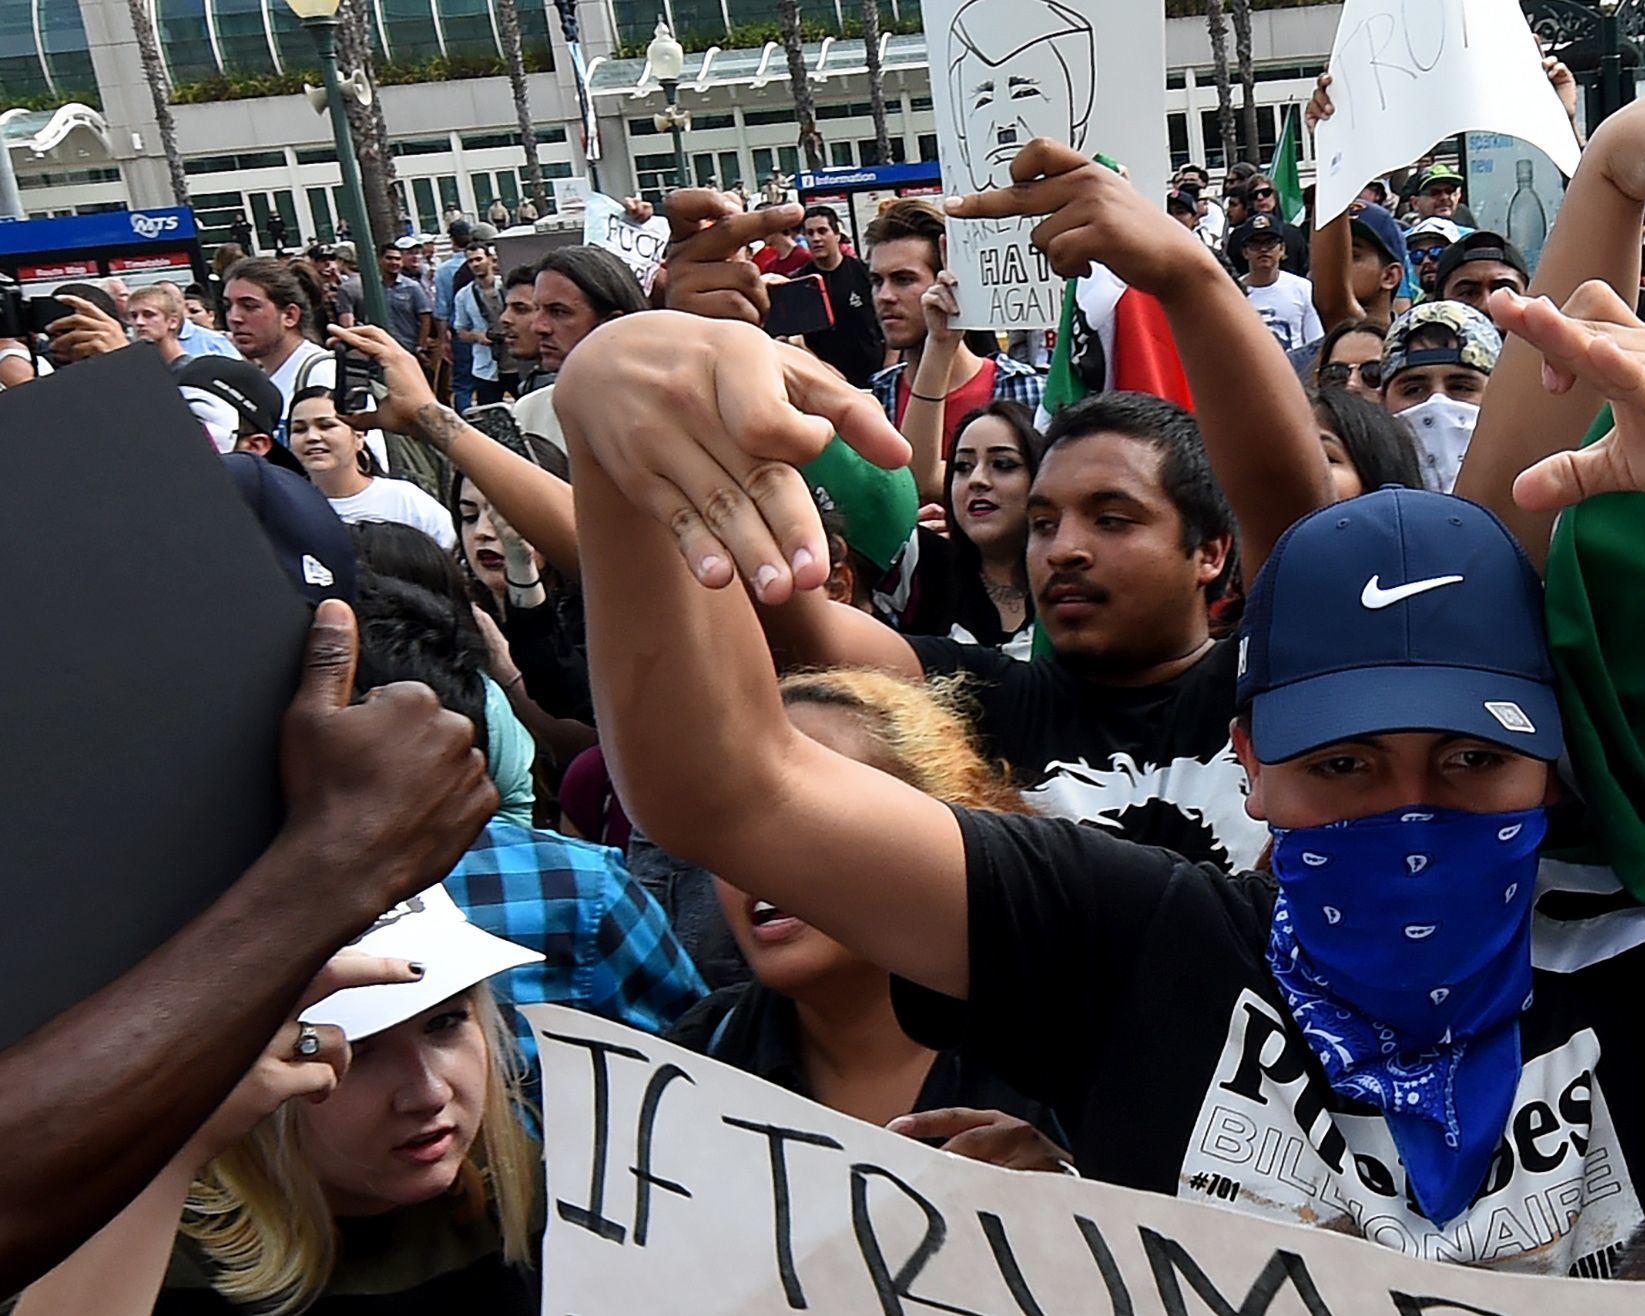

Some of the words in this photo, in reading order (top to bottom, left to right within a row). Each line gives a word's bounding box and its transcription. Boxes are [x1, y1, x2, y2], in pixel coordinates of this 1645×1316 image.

[815, 172, 877, 186] Information
[134, 215, 179, 234] MTS
[606, 213, 665, 263] FUCK
[980, 244, 1066, 287] HAT
[990, 288, 1064, 325] AGAI
[543, 1029, 696, 1247] If
[1190, 1171, 1241, 1203] #701
